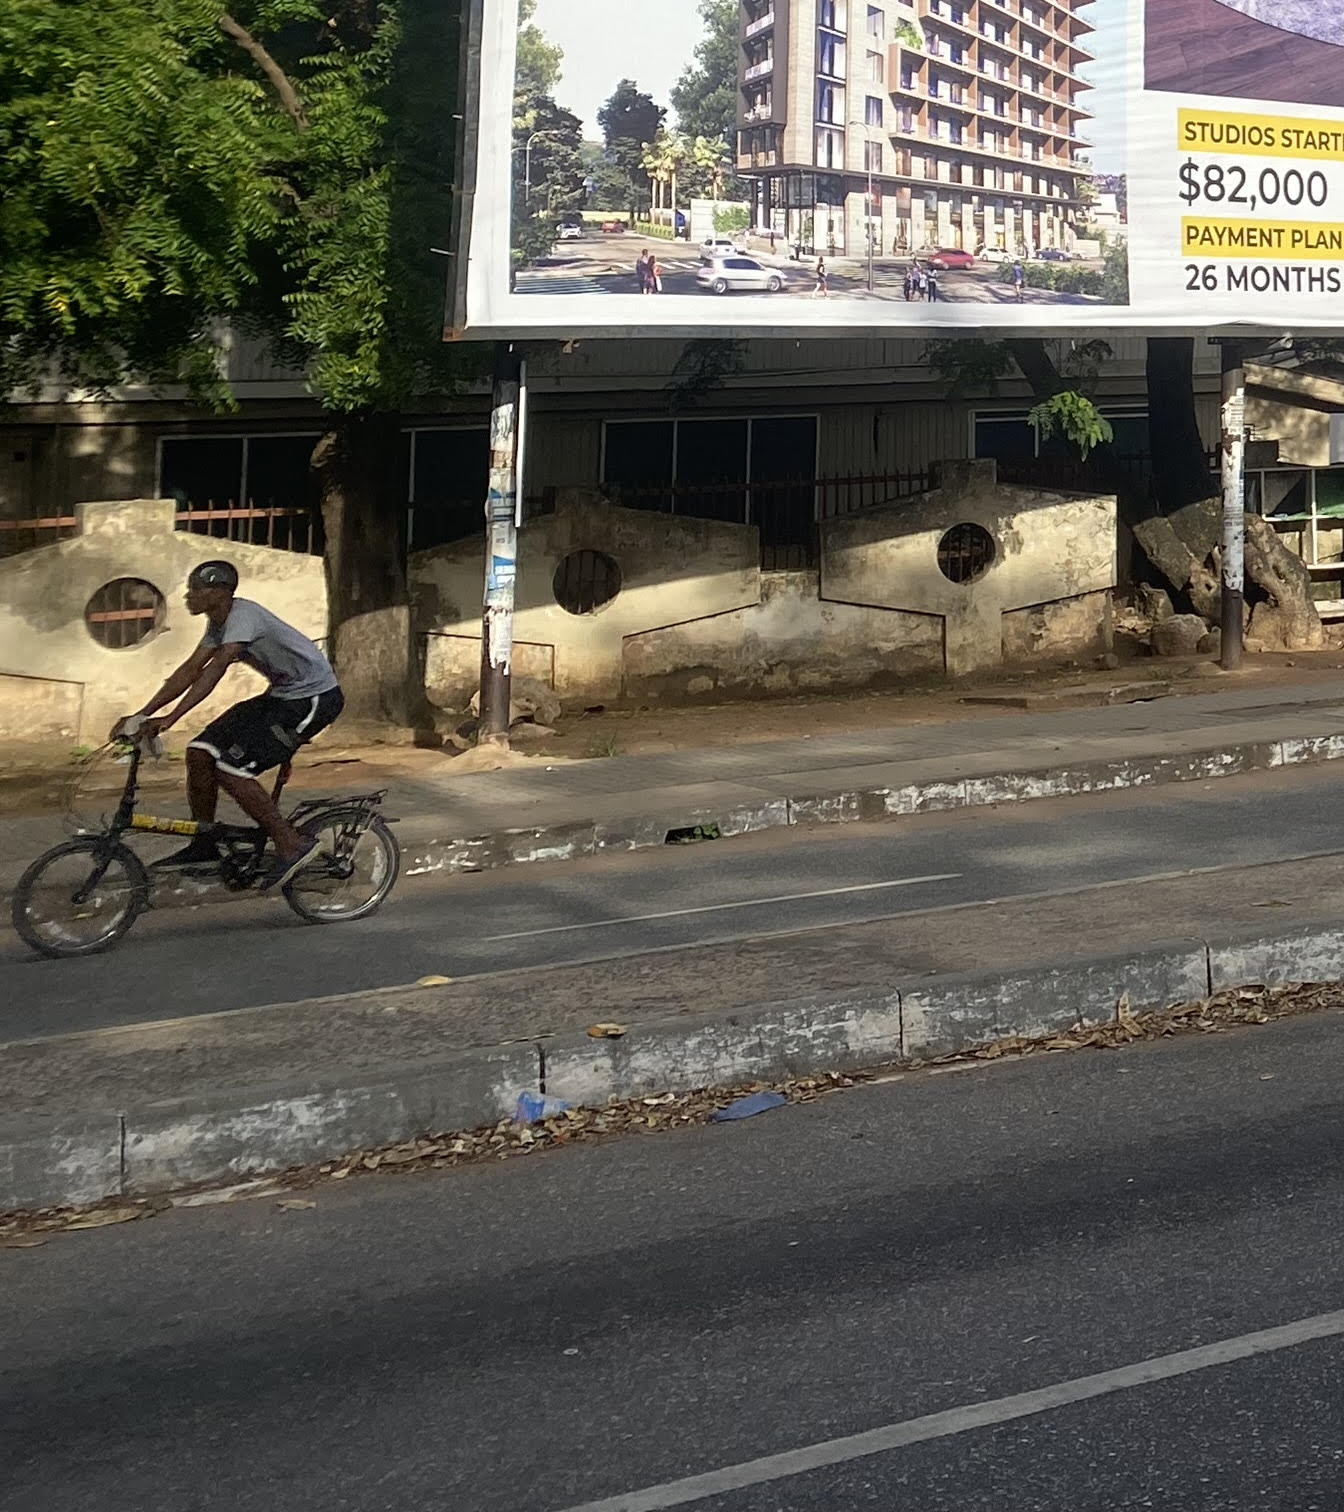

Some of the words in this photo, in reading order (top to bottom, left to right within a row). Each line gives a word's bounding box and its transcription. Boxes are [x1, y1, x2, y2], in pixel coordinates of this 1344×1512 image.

[1184, 120, 1276, 148] STUDIOS
[1178, 156, 1329, 212] $82,000
[1185, 225, 1286, 249] PAYMENT
[1290, 228, 1343, 250] PLAN
[1184, 263, 1218, 291] 26
[1226, 264, 1342, 293] MONTHS
